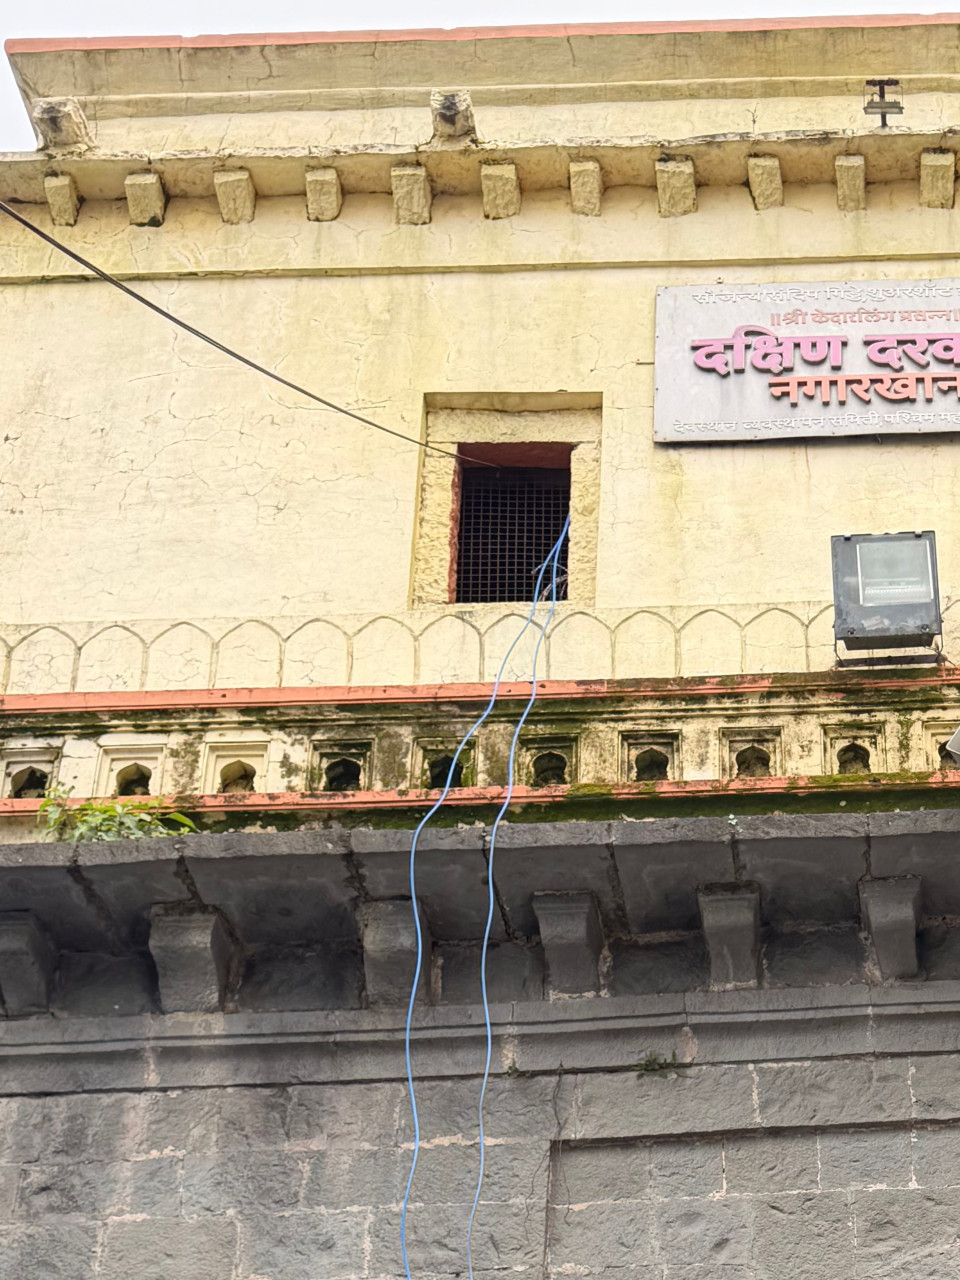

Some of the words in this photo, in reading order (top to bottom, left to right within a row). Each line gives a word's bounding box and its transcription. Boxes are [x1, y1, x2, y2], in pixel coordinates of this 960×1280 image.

[811, 307, 896, 325] केदारलिंग
[691, 324, 848, 375] दक्षिण
[673, 419, 737, 433] देवस्थान
[742, 416, 825, 431] व्यवस्थापन
